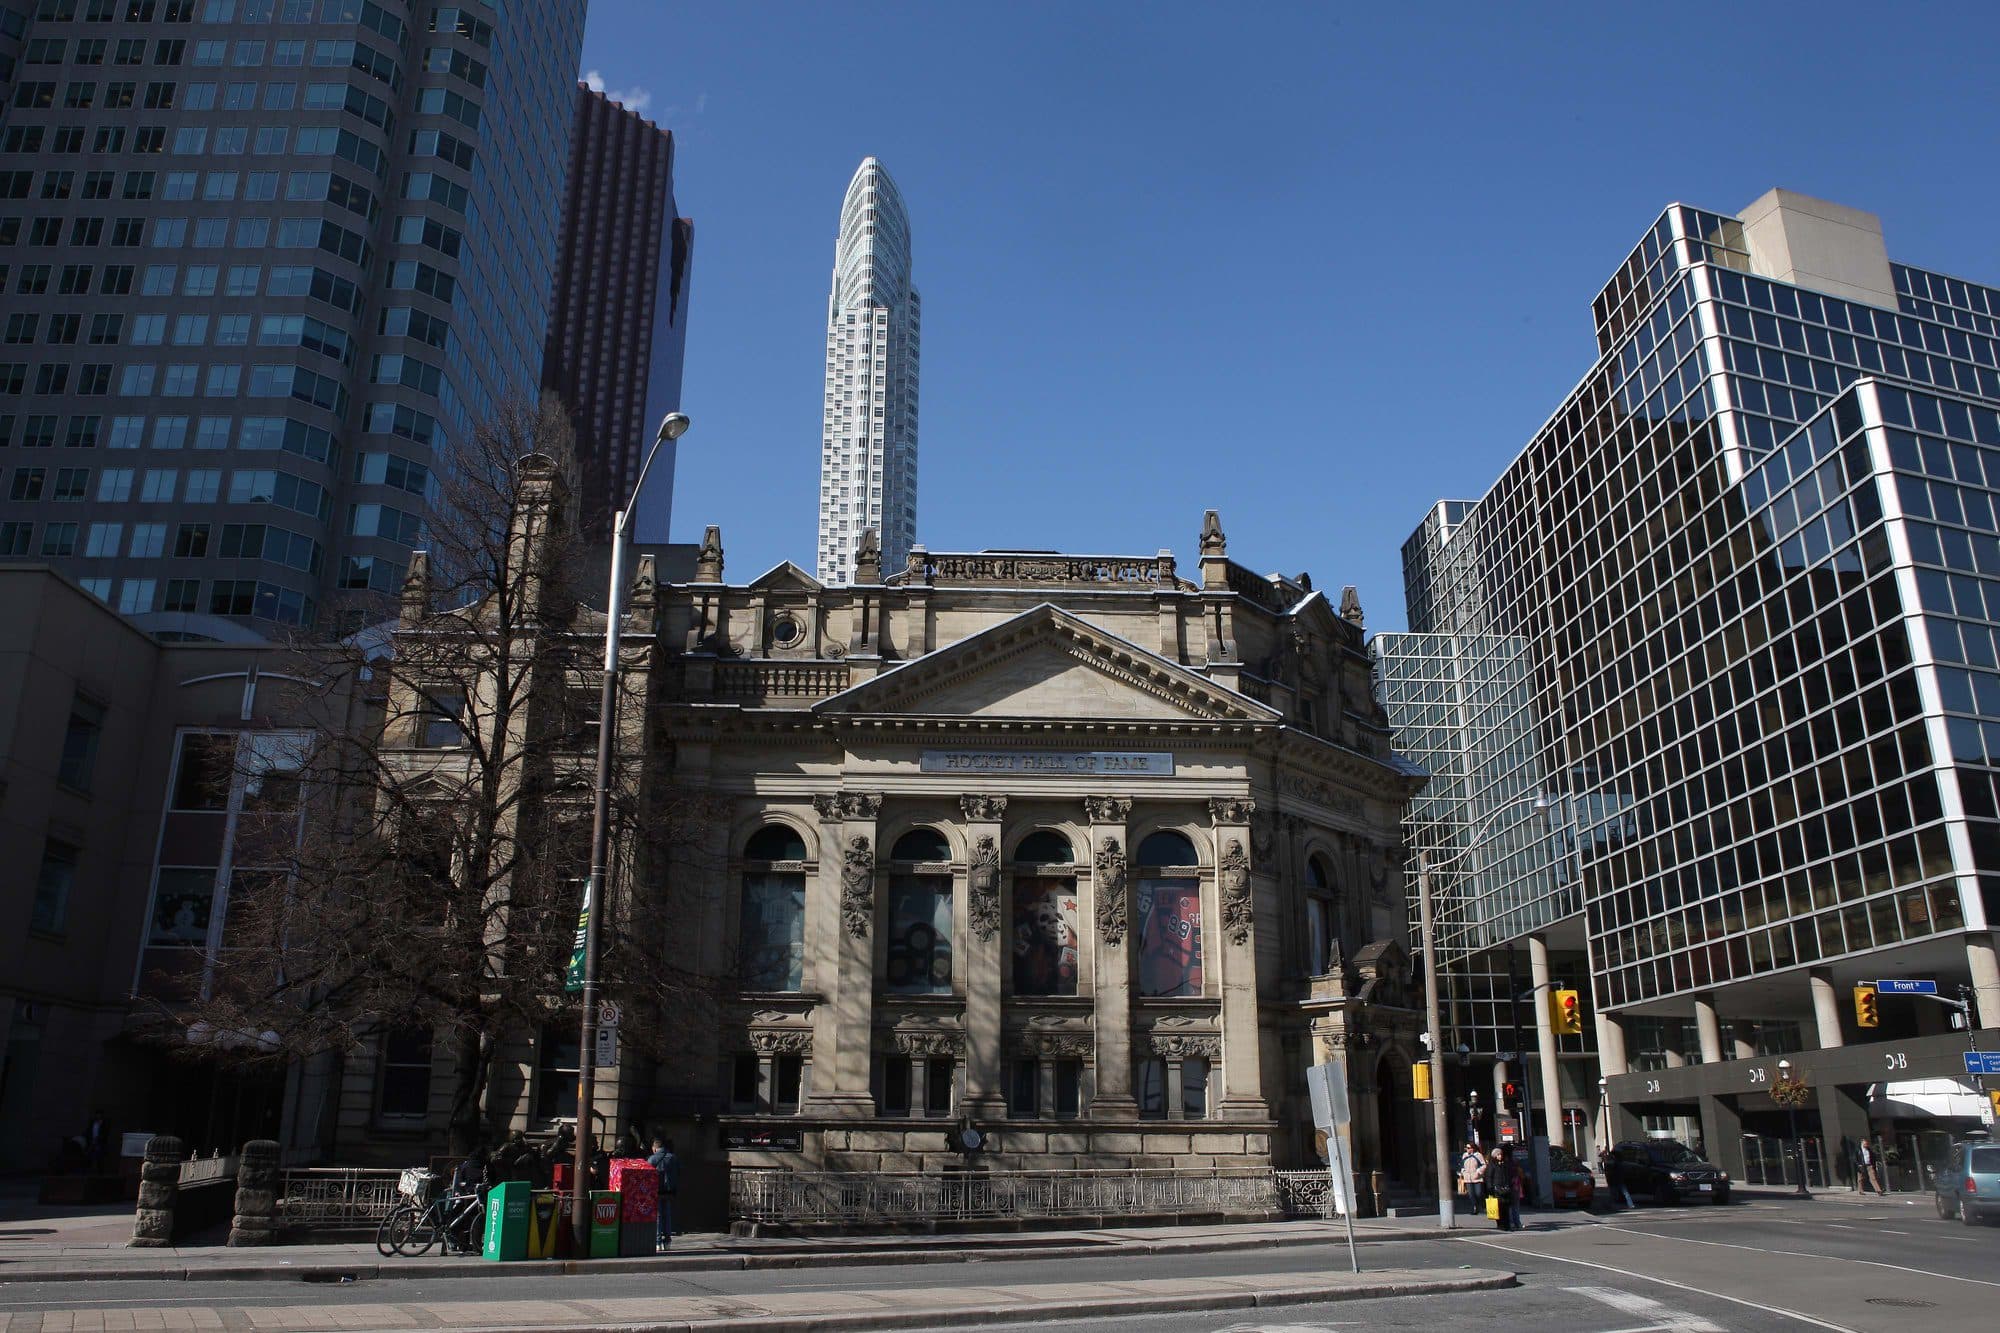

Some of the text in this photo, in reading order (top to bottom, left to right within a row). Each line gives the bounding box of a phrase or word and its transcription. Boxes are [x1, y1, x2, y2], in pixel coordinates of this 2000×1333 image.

[945, 754, 1149, 771] HOCKEY HALL OF FAME
[1893, 981, 1915, 991] Front
[596, 1205, 617, 1219] NOW
